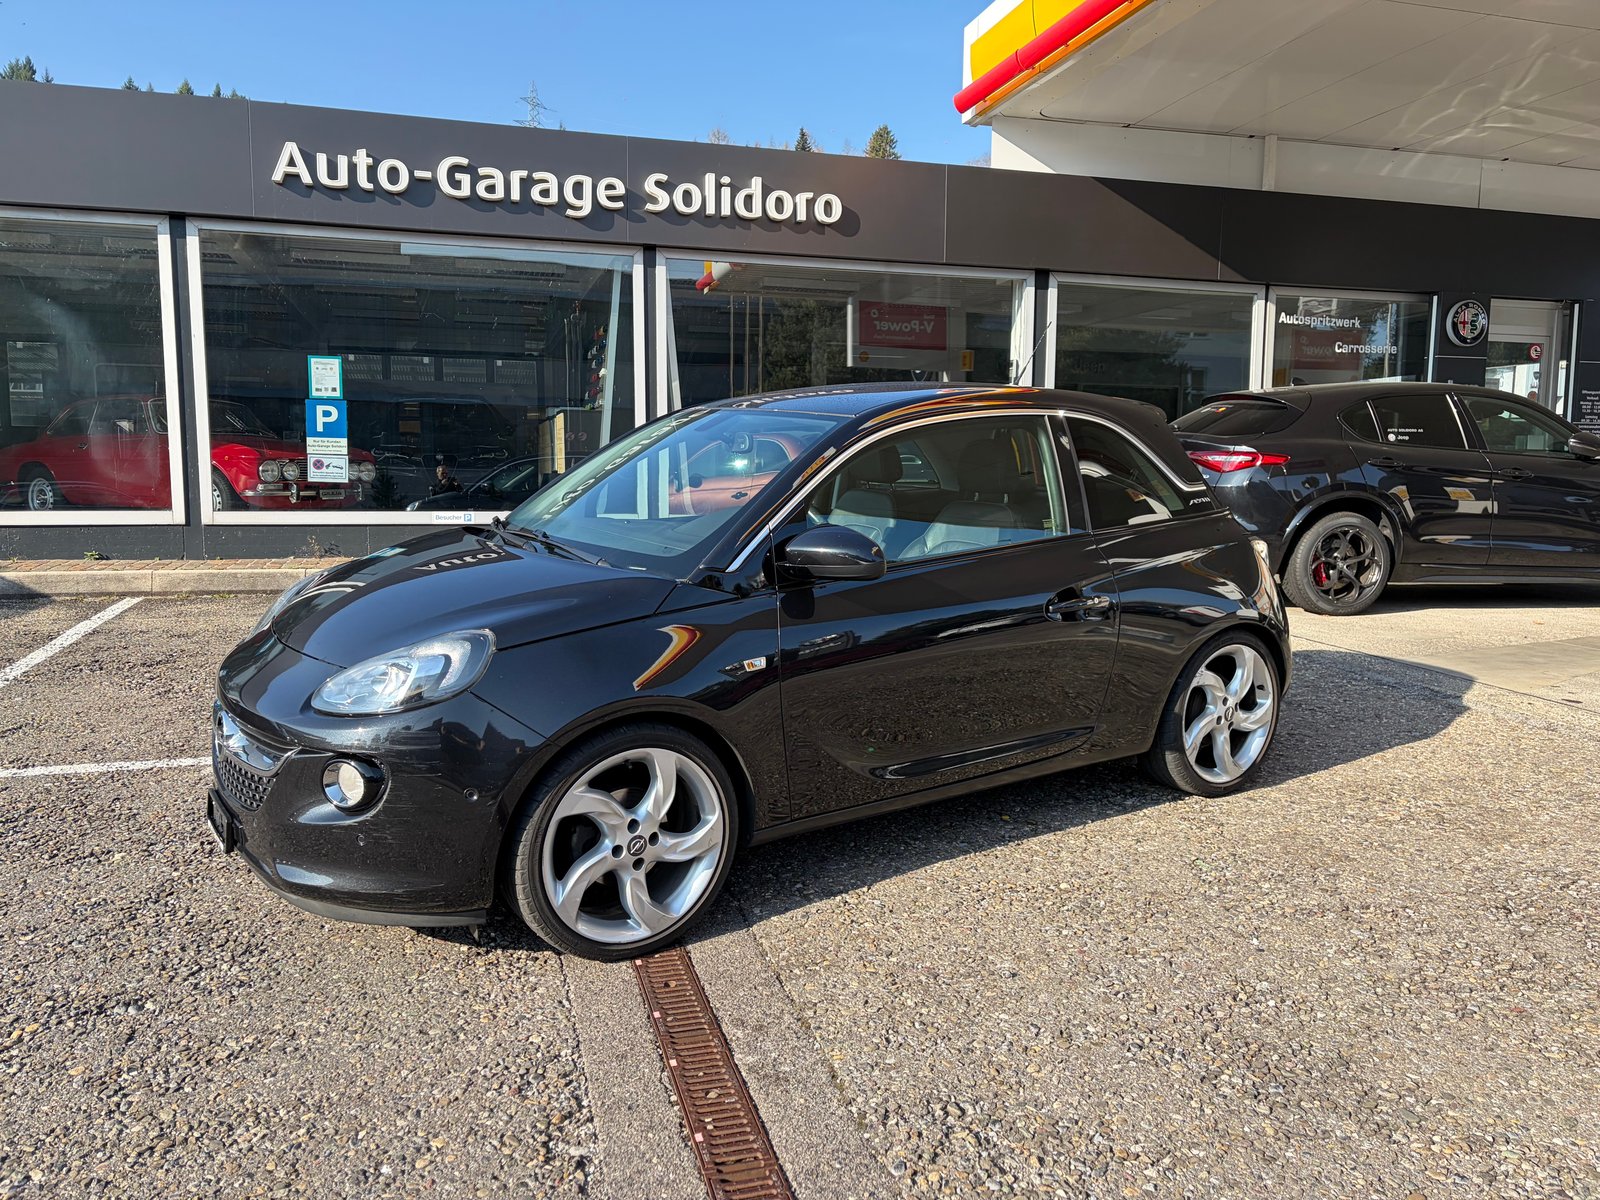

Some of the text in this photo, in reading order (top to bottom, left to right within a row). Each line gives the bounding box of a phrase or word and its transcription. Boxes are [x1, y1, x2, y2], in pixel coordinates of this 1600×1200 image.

[272, 141, 844, 225] Auto-Garage Solidoro
[1279, 312, 1361, 328] Autospritzwerk
[1335, 341, 1398, 354] Carrosserie
[316, 405, 339, 432] P
